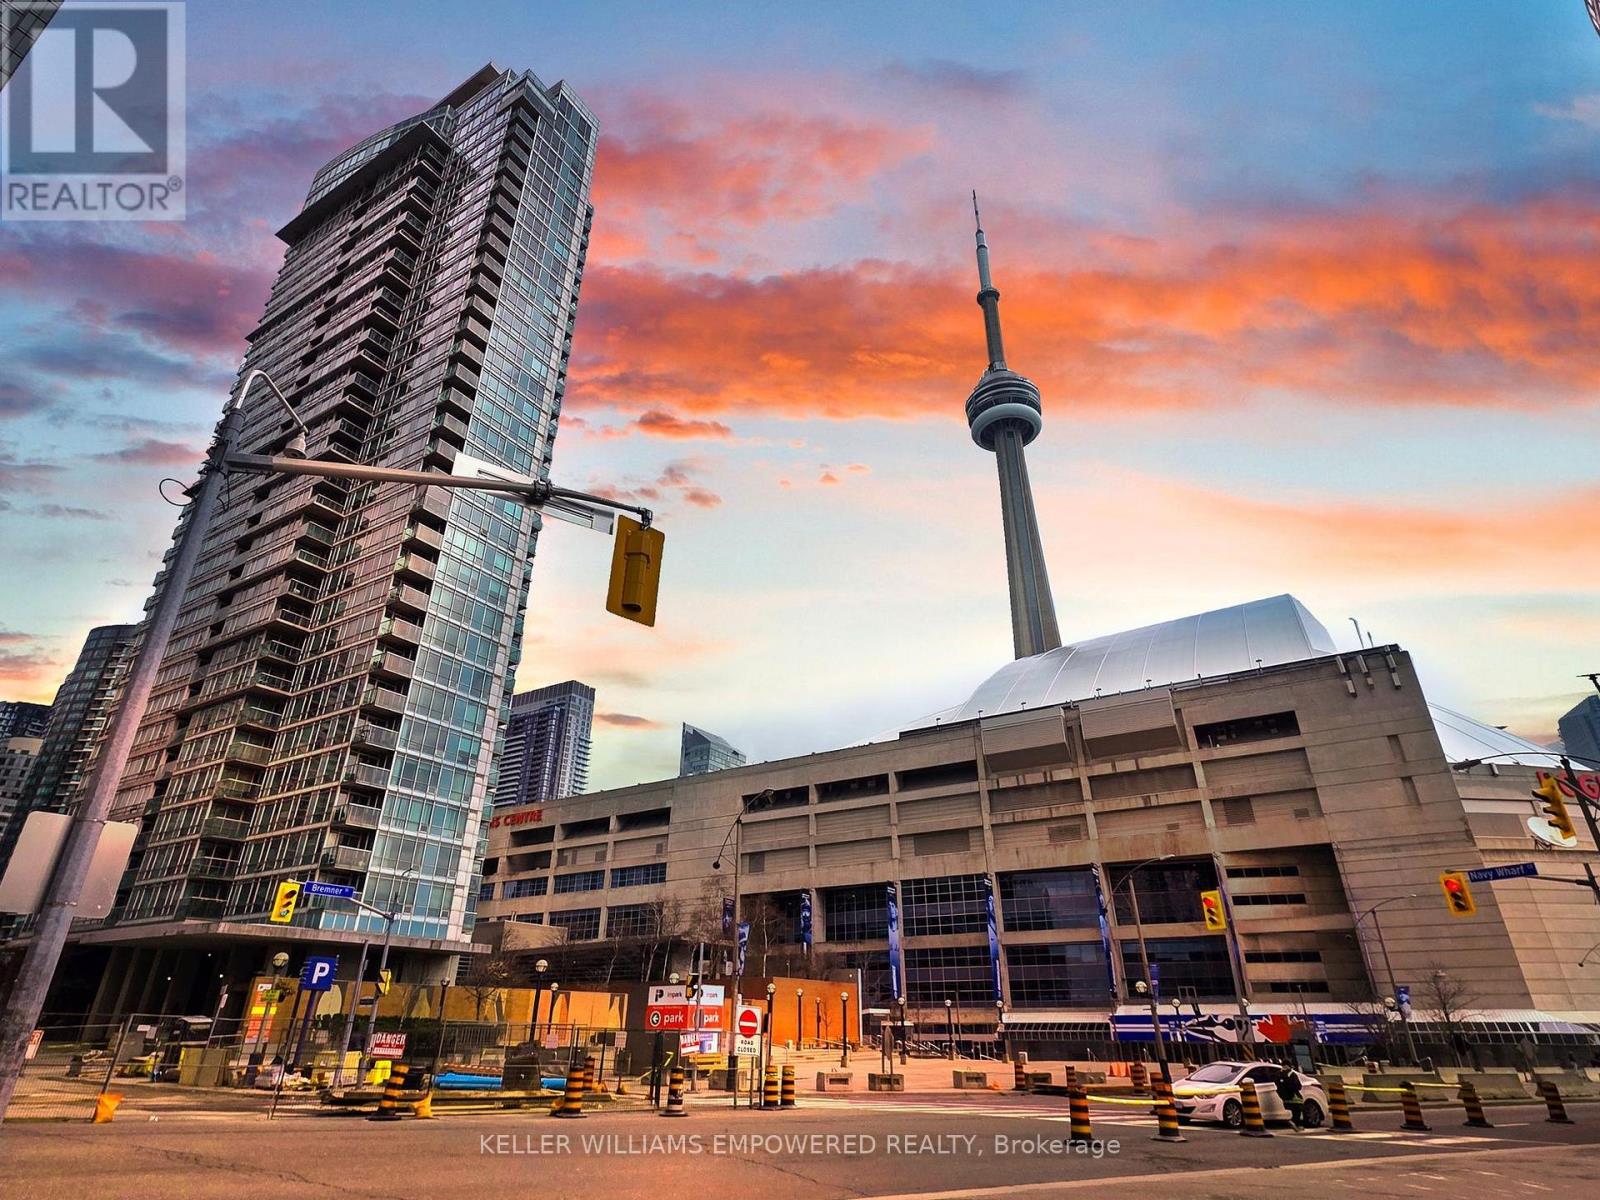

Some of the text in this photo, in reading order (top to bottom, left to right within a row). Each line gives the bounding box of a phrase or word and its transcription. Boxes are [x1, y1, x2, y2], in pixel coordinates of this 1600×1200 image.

[504, 809, 543, 826] CENTRE
[1469, 870, 1493, 881] Navy
[1495, 865, 1526, 877] Wharf
[311, 883, 343, 895] Bremner
[312, 962, 330, 984] P
[663, 1011, 683, 1026] park
[704, 1011, 720, 1025] park
[375, 1032, 406, 1045] DANGER
